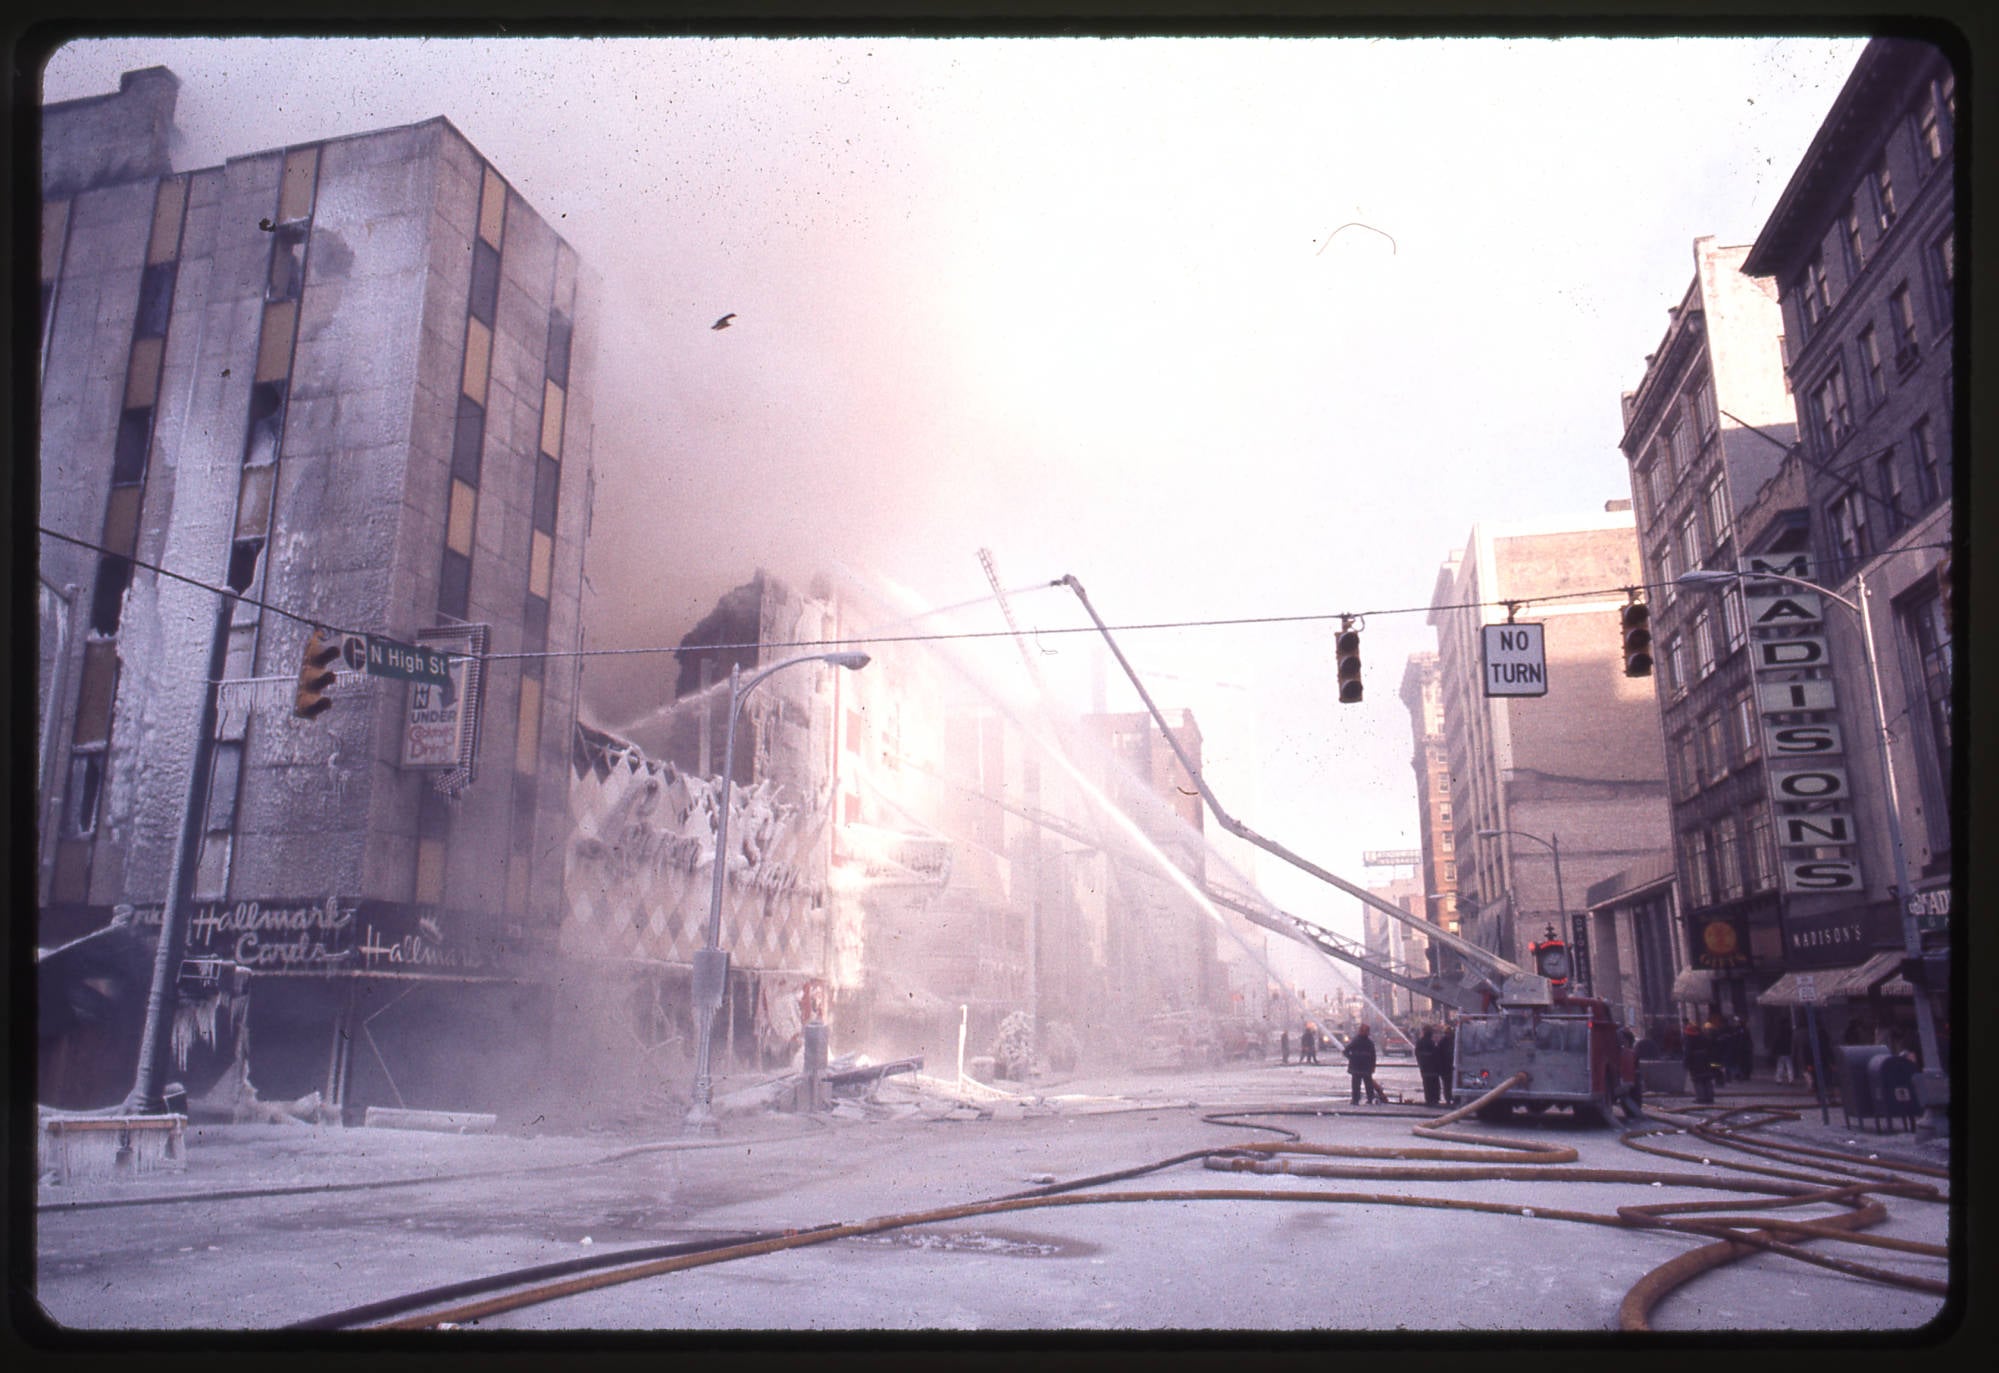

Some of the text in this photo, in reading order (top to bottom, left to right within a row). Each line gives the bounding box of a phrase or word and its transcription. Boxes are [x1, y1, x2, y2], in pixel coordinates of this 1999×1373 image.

[1501, 631, 1529, 651] NO
[370, 645, 445, 675] N High St
[1491, 663, 1542, 684] TURN
[411, 710, 457, 723] UNDER
[1752, 556, 1853, 889] MADISONS
[192, 895, 357, 946] Hallmark
[235, 931, 350, 965] Cards
[1793, 924, 1862, 948] MADISON'S
